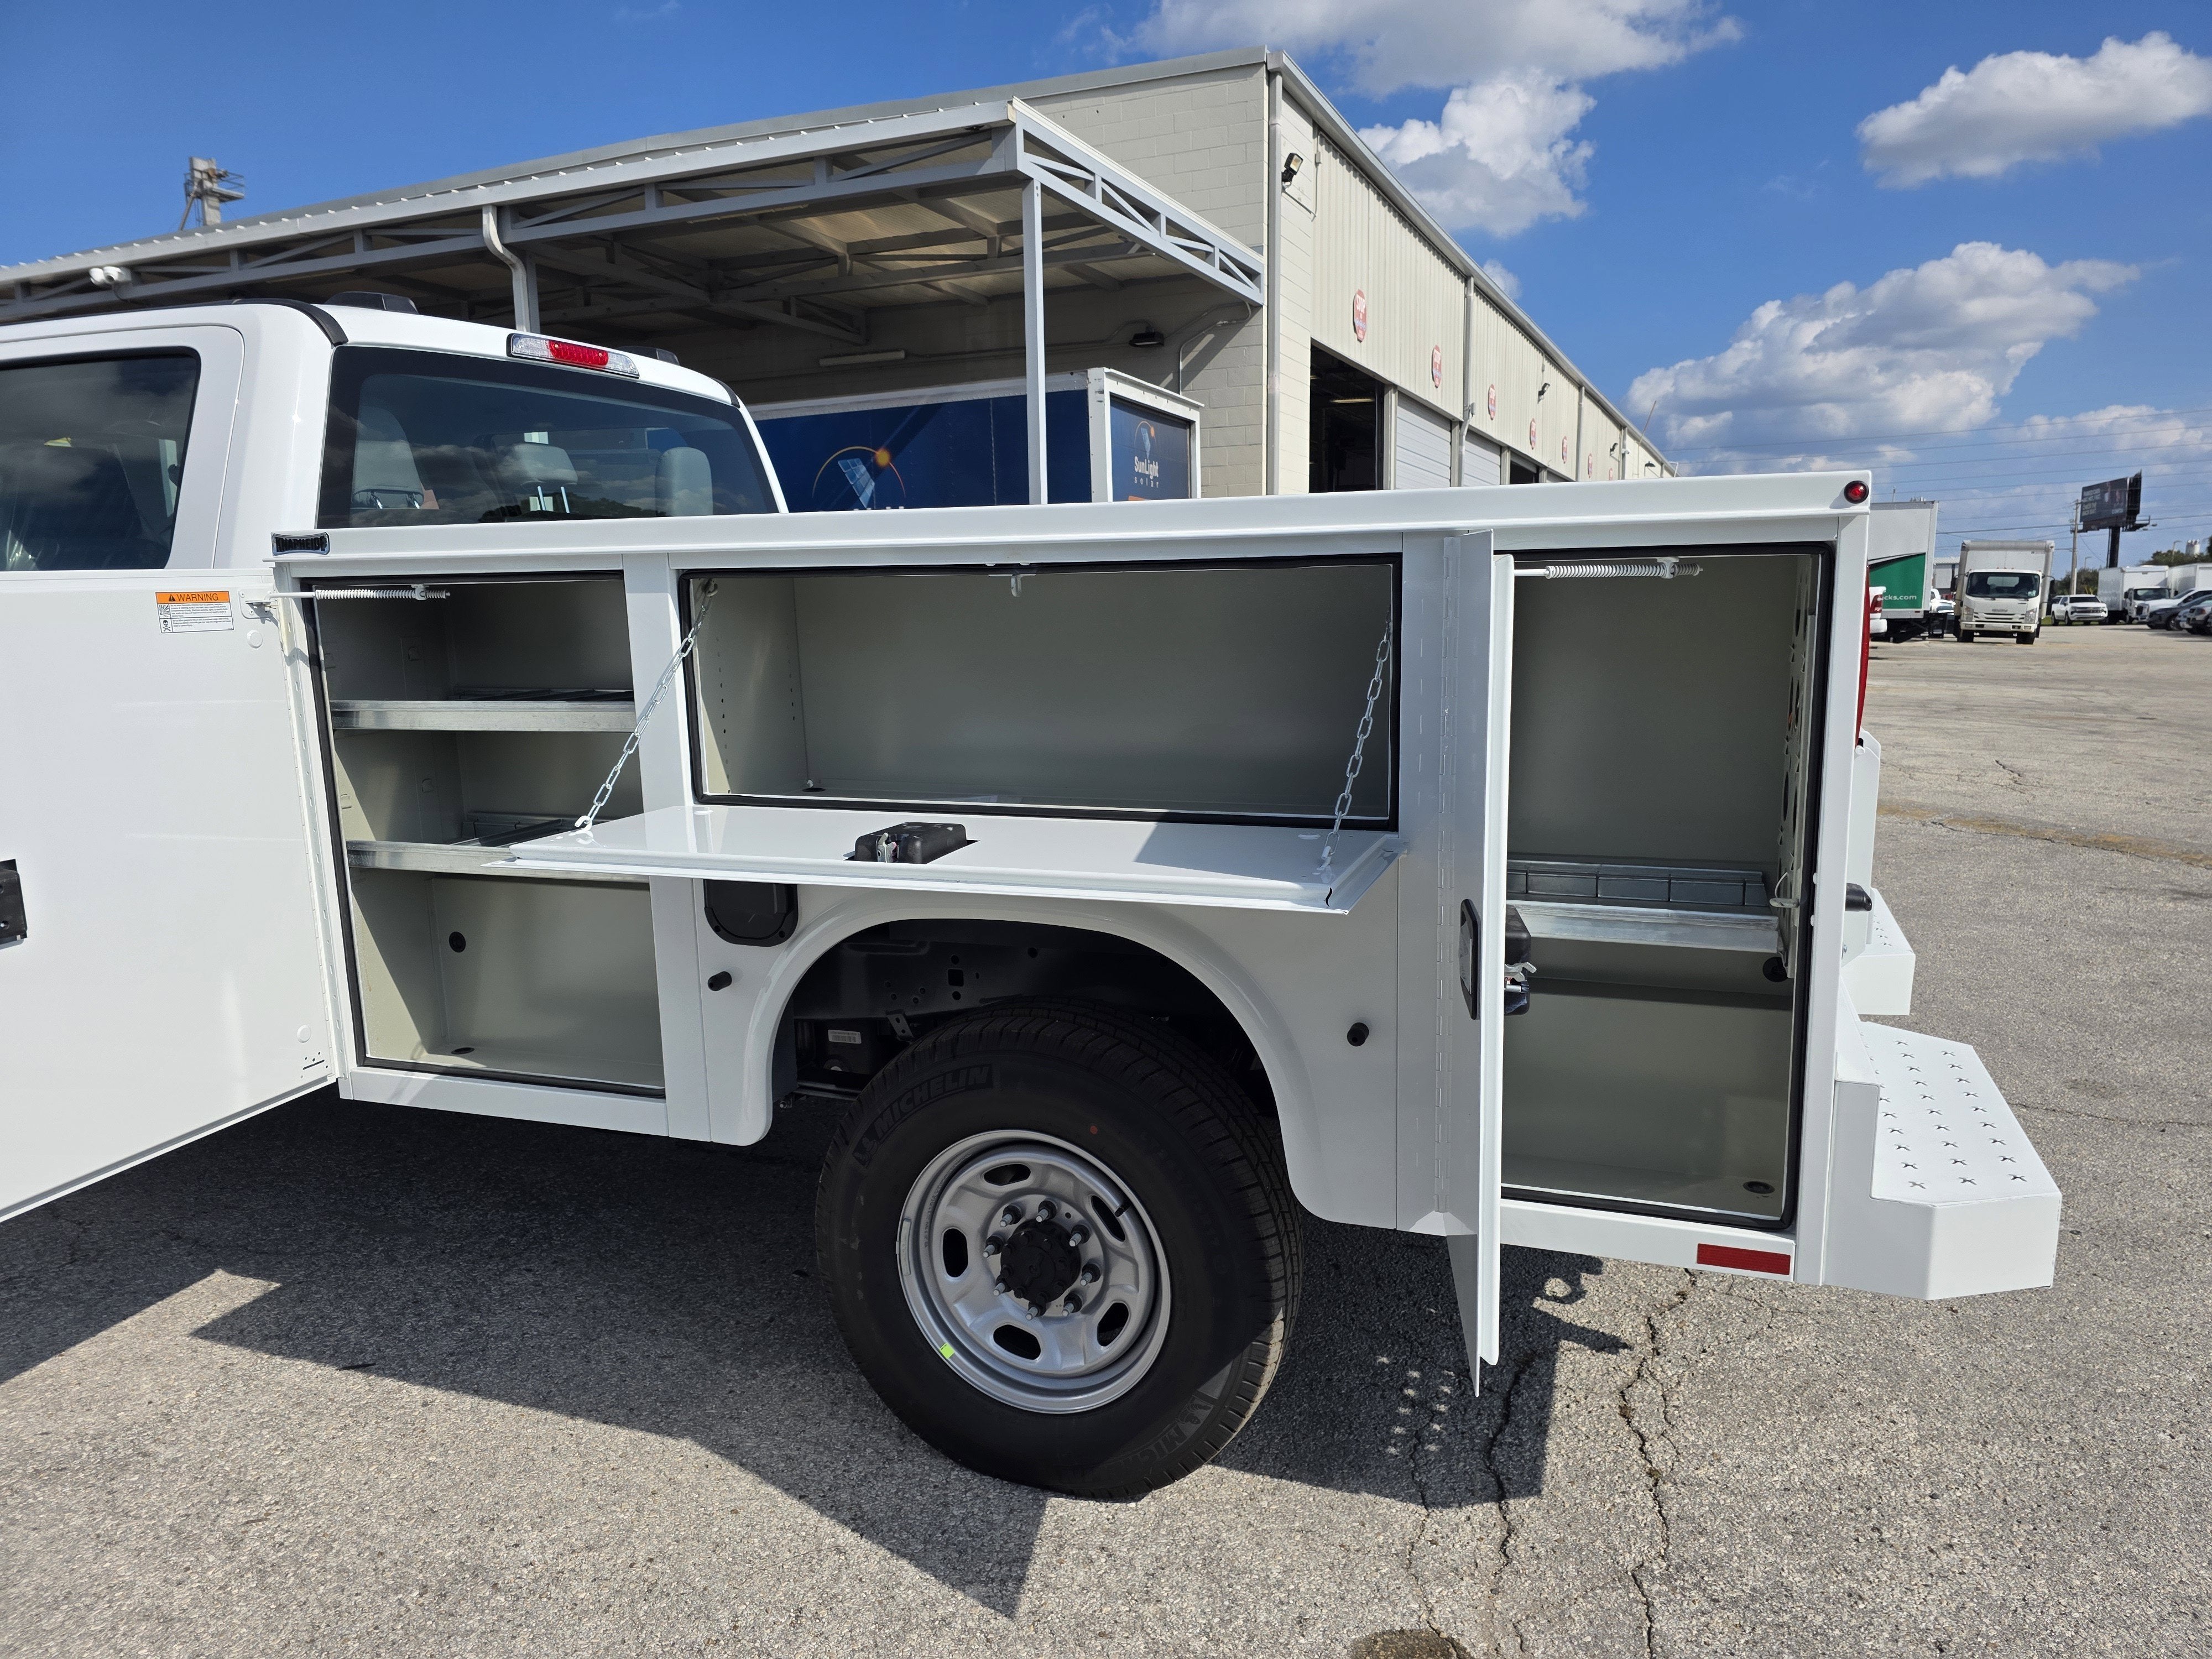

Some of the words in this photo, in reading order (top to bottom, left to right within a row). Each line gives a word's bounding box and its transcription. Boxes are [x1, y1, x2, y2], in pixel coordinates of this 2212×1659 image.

[1135, 456, 1159, 479] SunLight
[1135, 477, 1159, 488] solar
[275, 535, 327, 552] KNAPHEIDE
[176, 593, 219, 602] WARNING
[873, 1065, 990, 1141] MICHELIN
